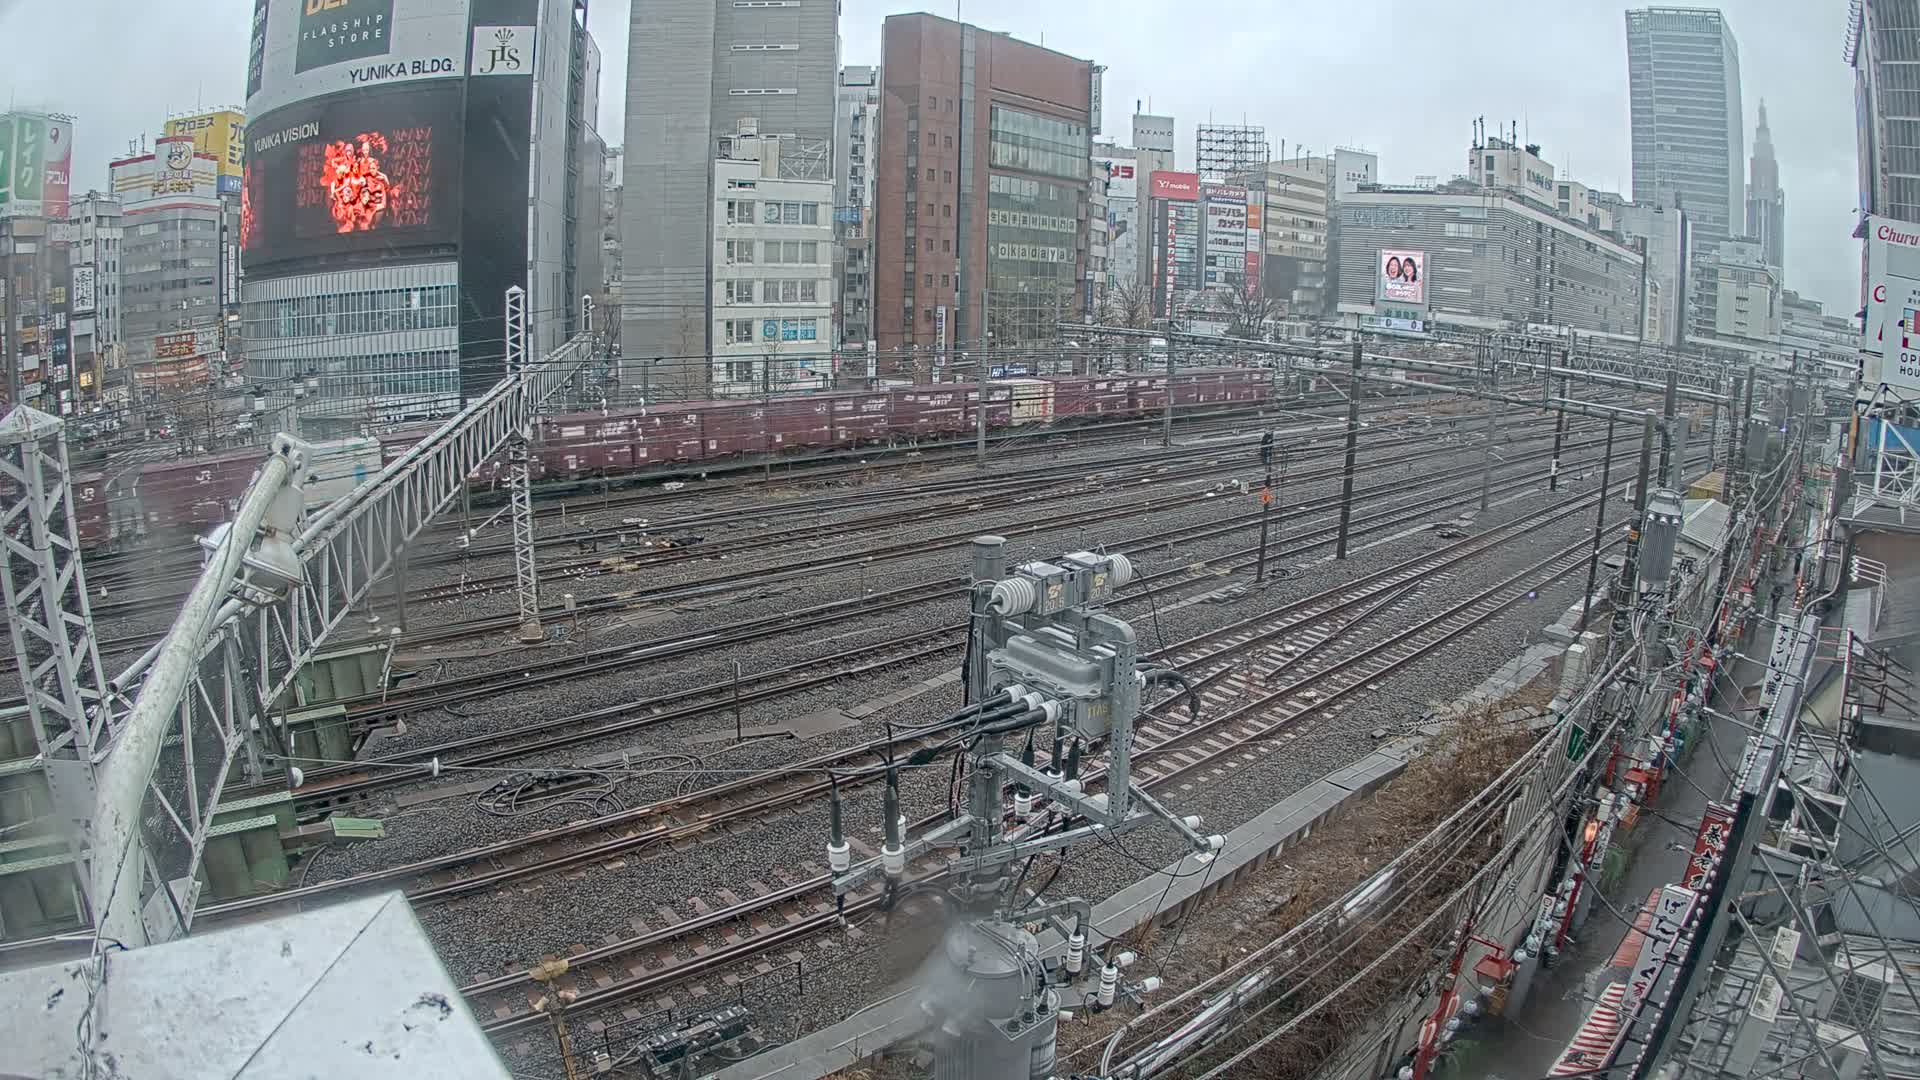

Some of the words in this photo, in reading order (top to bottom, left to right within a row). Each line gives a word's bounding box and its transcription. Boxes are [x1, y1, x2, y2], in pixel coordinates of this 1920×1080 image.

[303, 14, 383, 41] FLAGSHIP
[328, 28, 382, 48] STORE
[349, 60, 408, 84] YUNIKA
[411, 57, 456, 75] BLDG.
[176, 116, 214, 134] プロミス
[254, 133, 281, 152] YUNIKA
[282, 121, 320, 145] VISION
[1877, 225, 1919, 246] Churu
[1000, 246, 1066, 260] okadaya
[1900, 352, 1920, 366] OP
